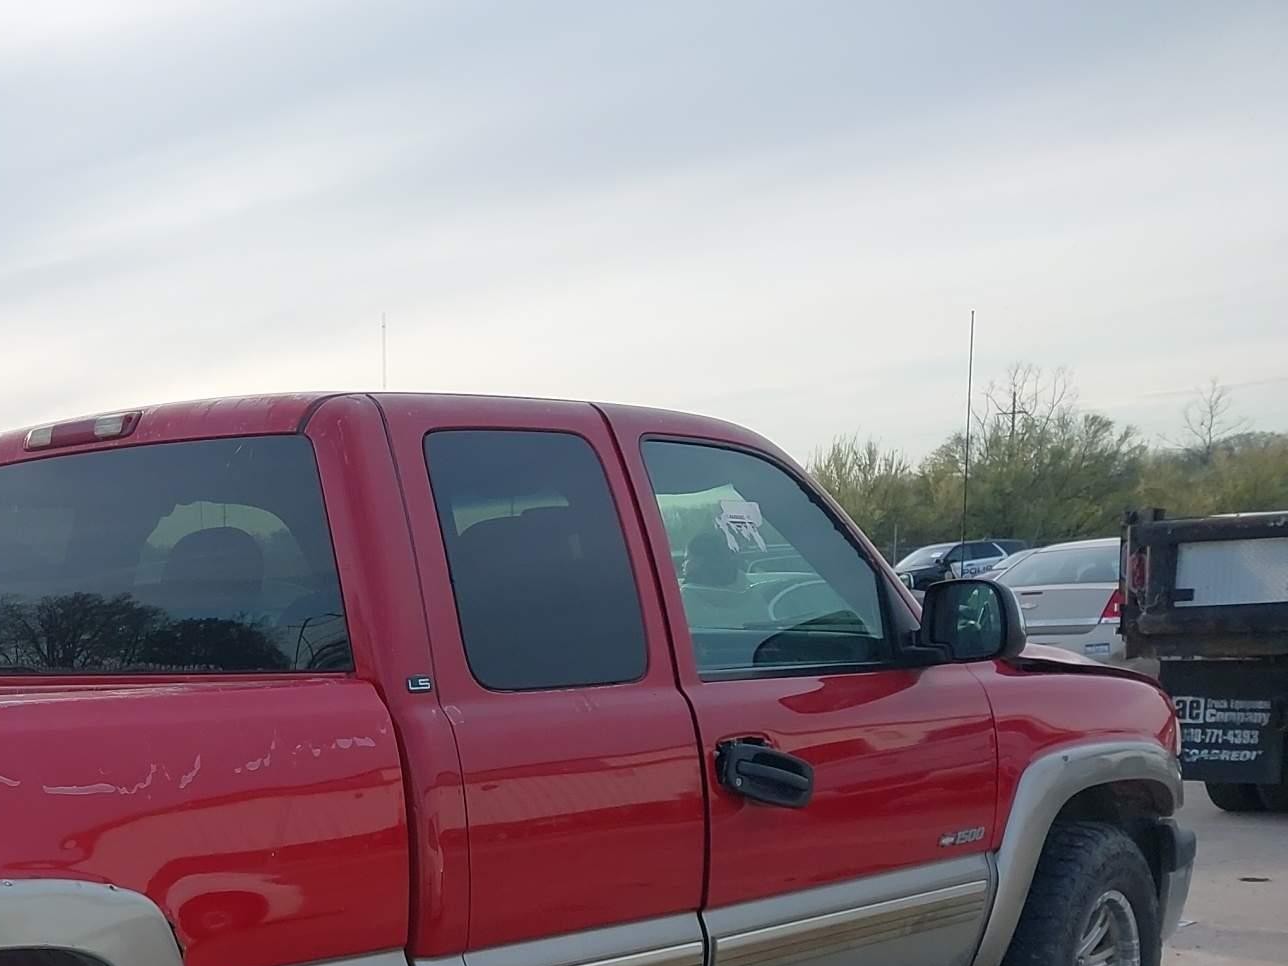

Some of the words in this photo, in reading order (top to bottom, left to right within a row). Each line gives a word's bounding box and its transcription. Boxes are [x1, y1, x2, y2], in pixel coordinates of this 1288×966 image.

[408, 678, 431, 690] LS
[1206, 709, 1272, 726] Company
[955, 826, 985, 845] 1500
